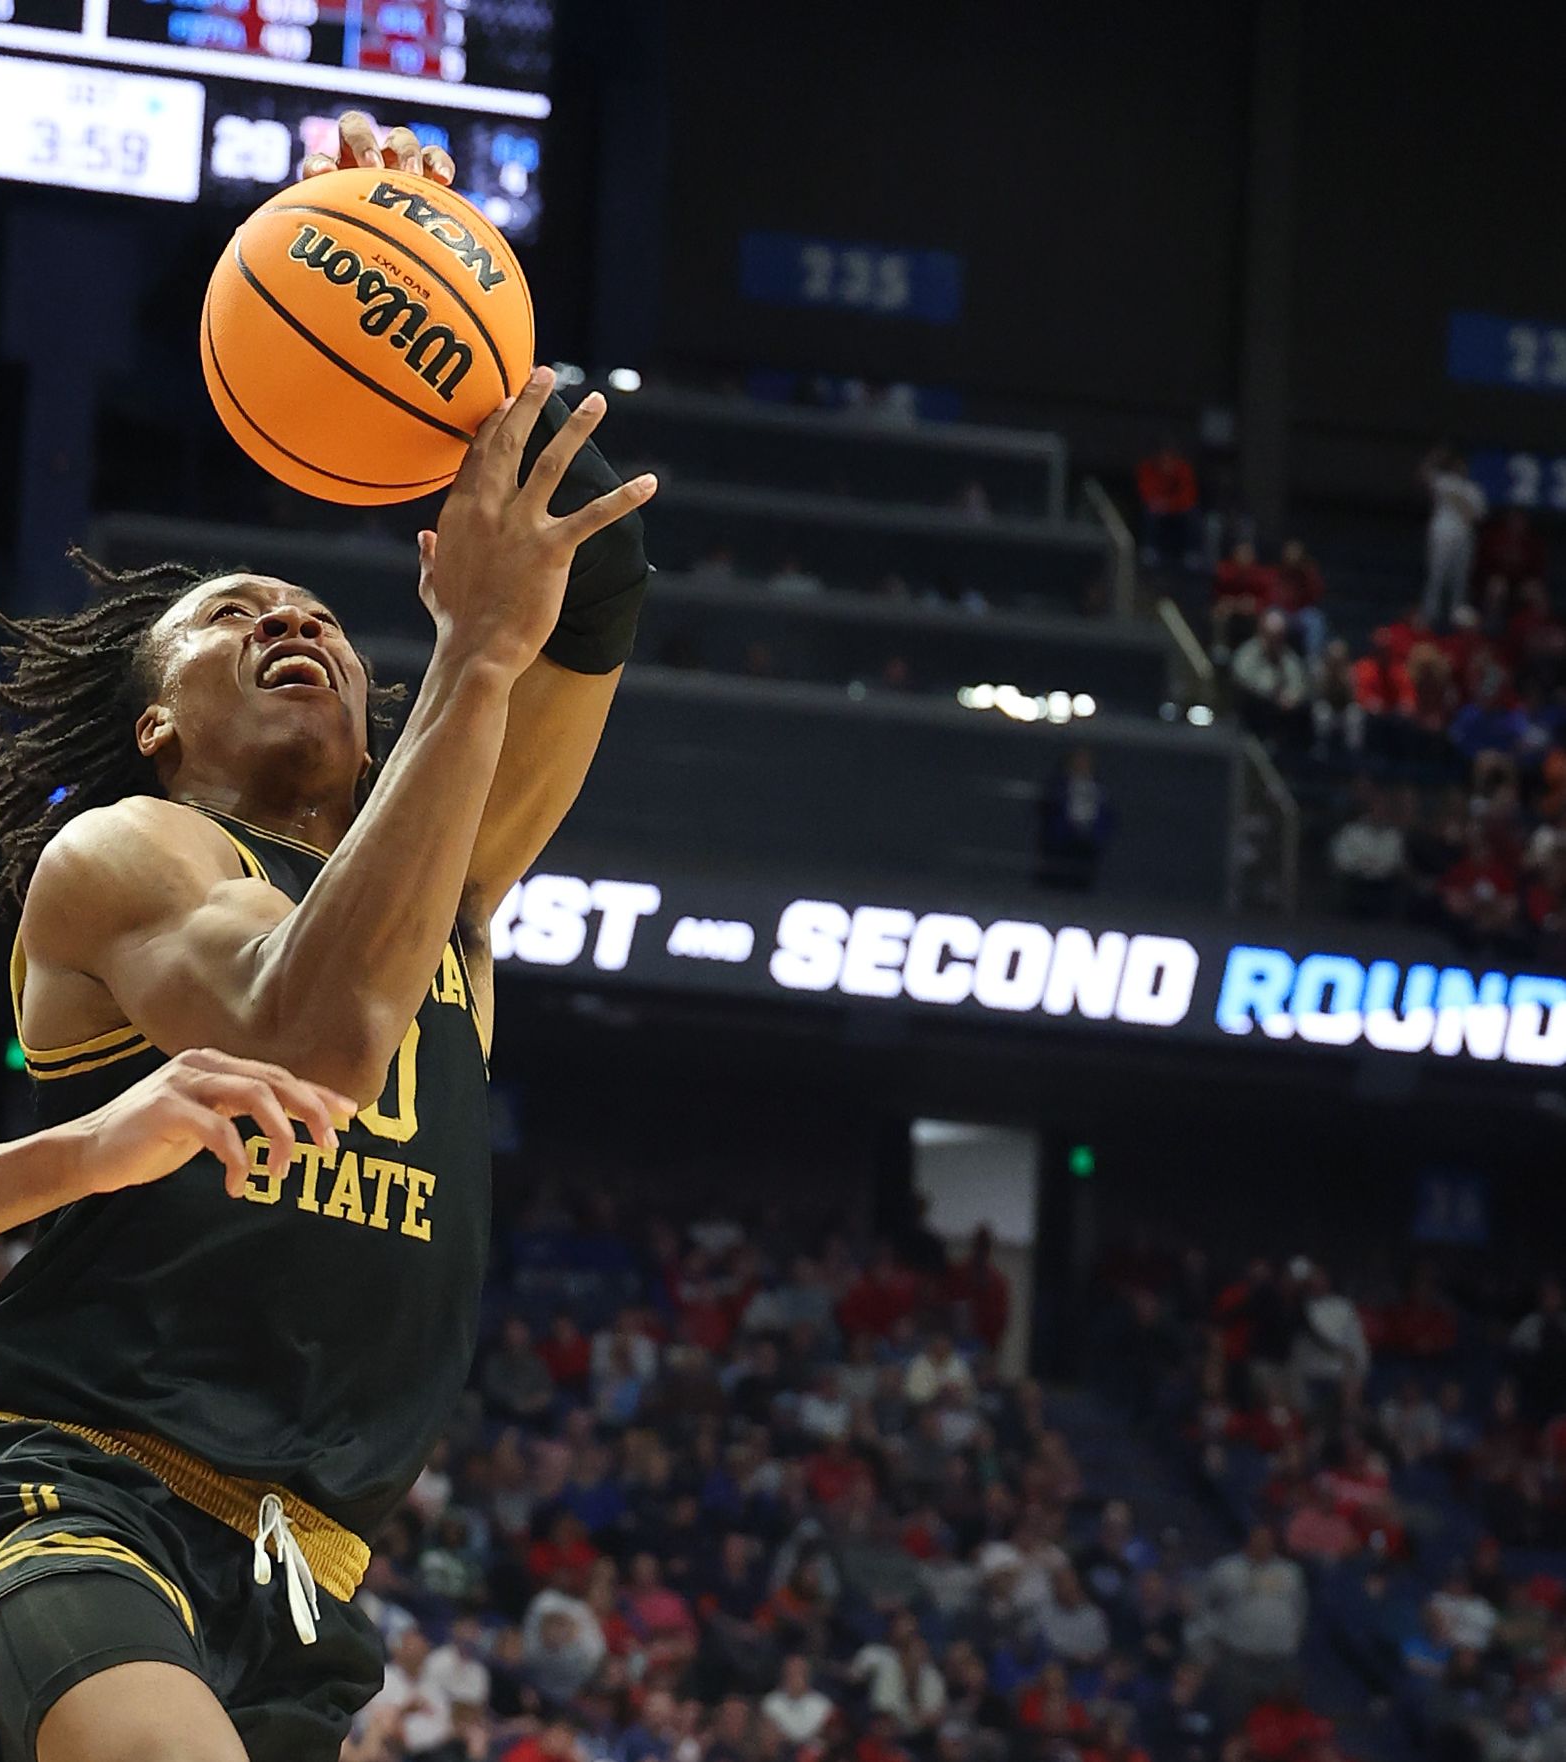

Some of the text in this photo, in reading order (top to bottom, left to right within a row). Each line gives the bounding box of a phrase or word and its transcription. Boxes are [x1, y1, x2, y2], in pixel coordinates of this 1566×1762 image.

[28, 116, 152, 178] 3:59
[368, 182, 507, 292] NCAA
[371, 253, 431, 300] EVO NXT
[289, 225, 474, 403] Wilson
[769, 898, 1199, 1027] SECOND
[1215, 944, 1566, 1067] ROUND
[244, 1135, 437, 1242] STATE
